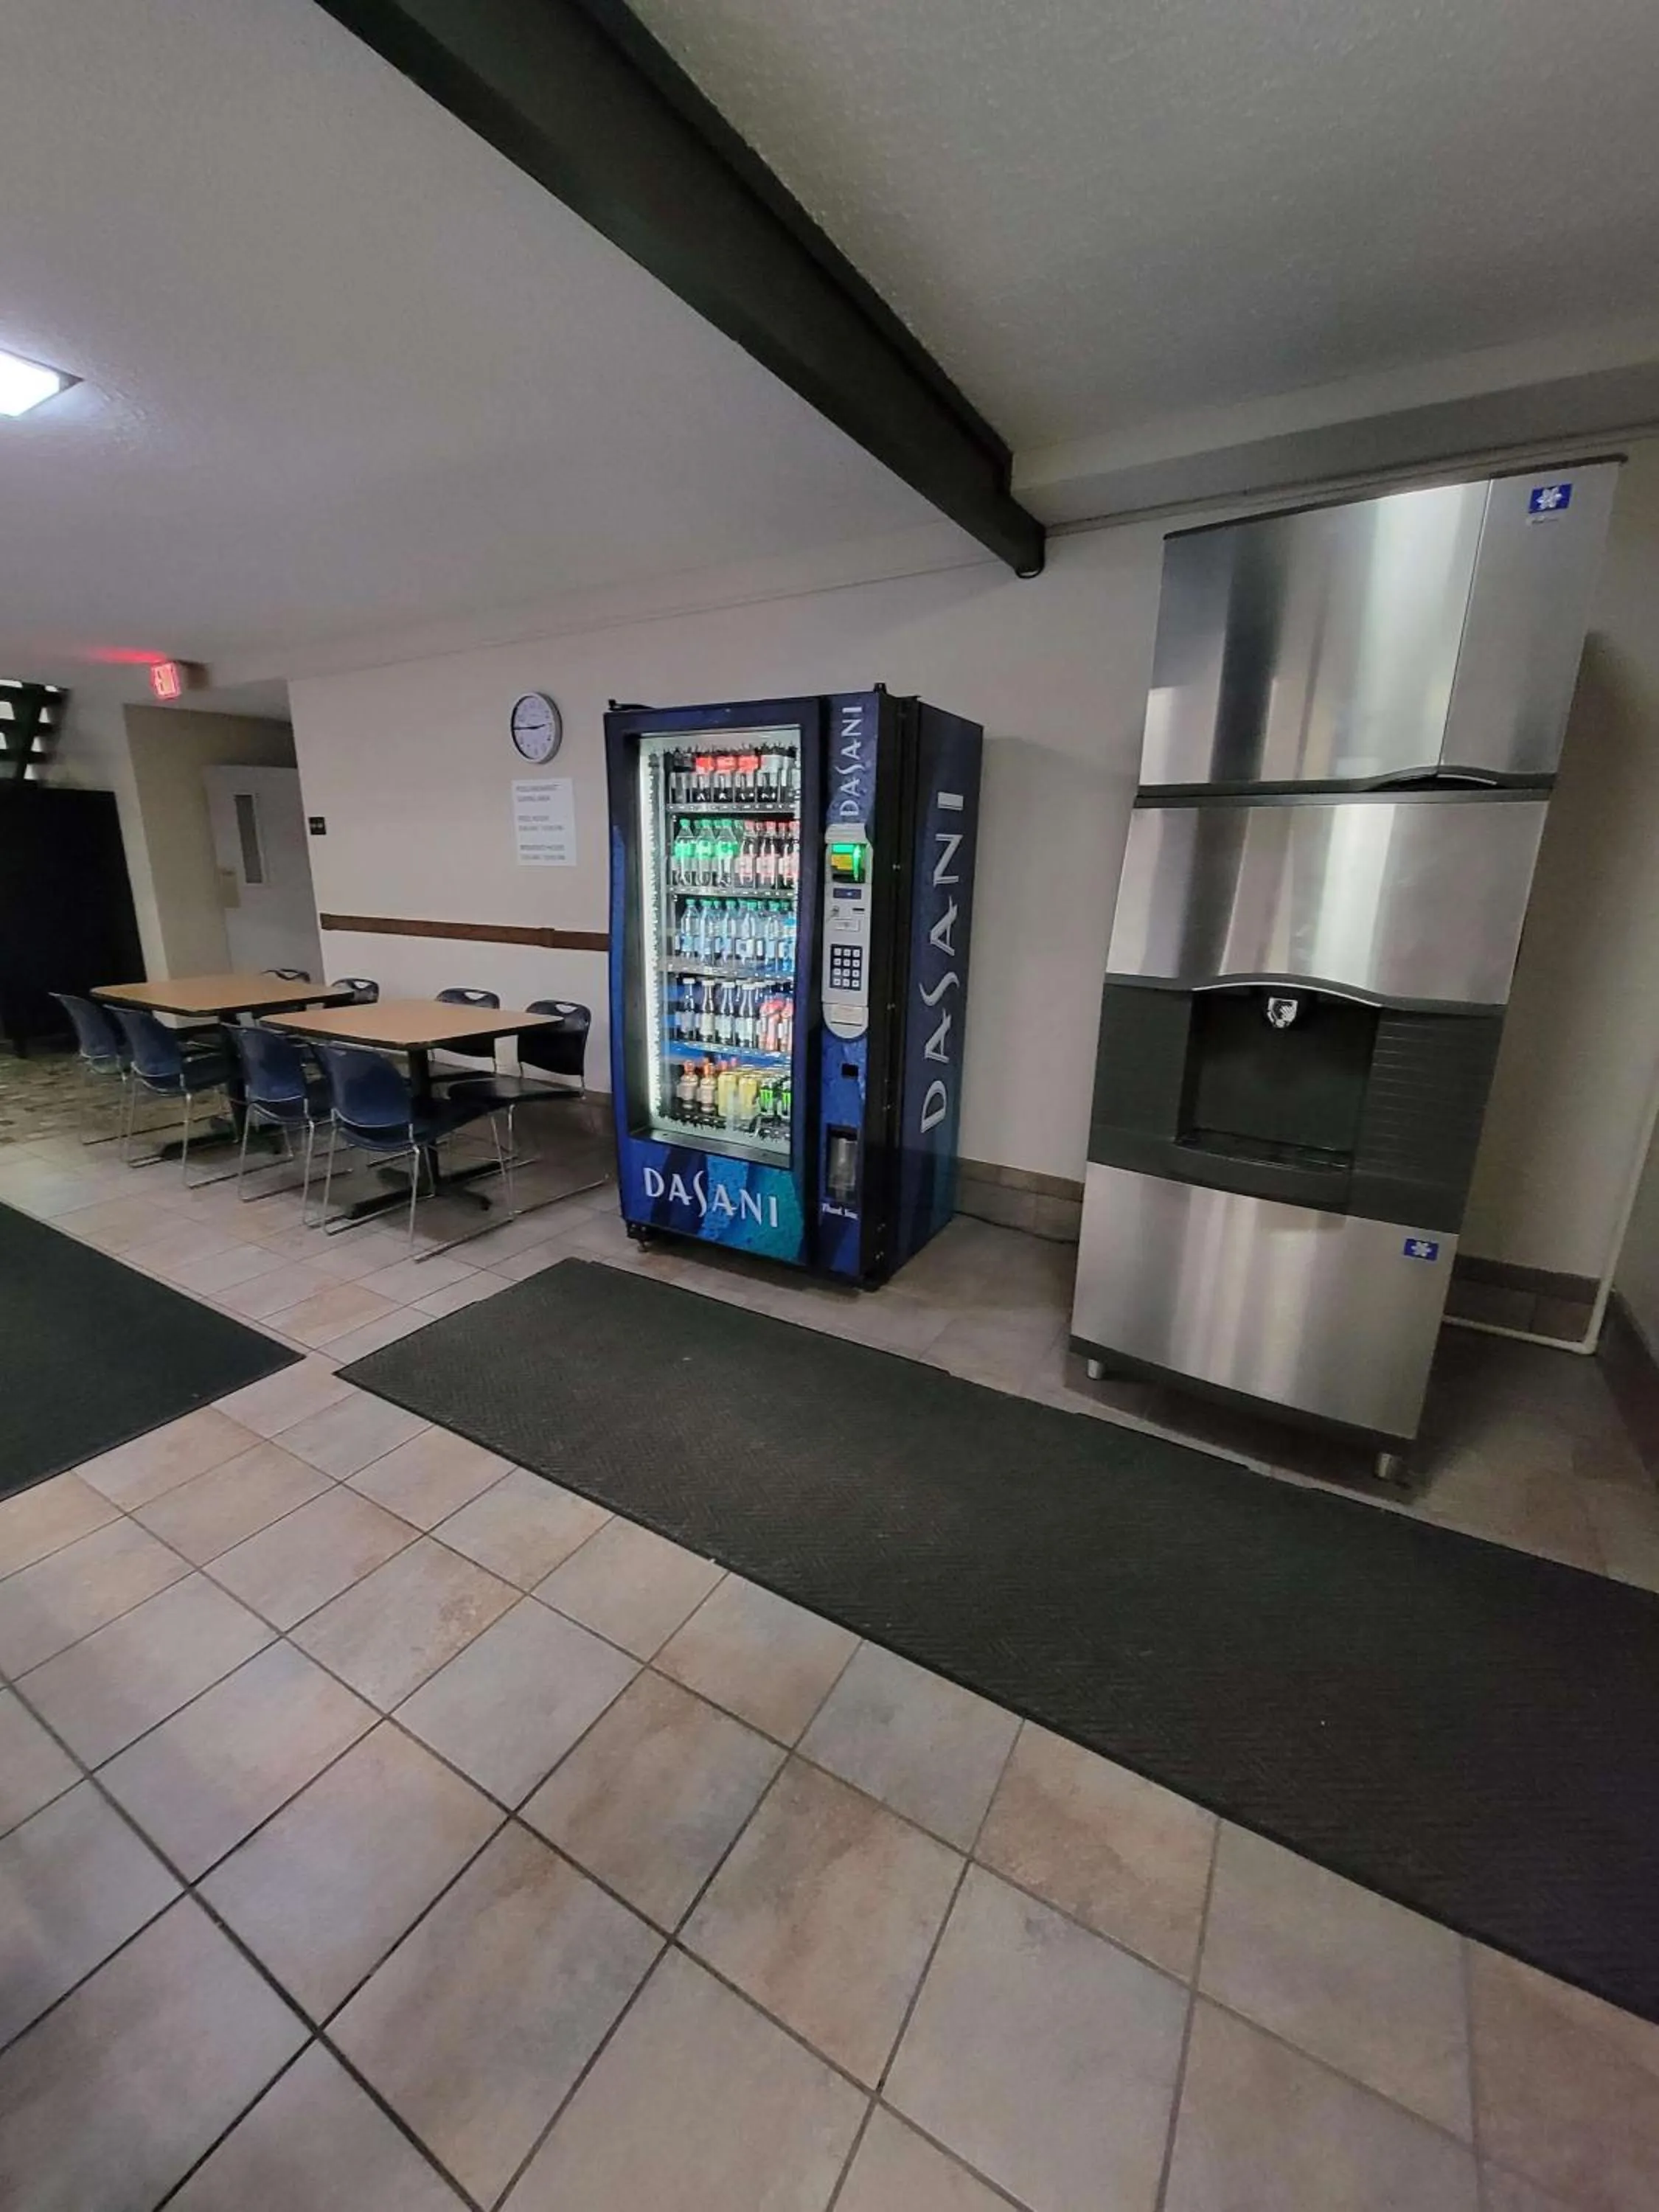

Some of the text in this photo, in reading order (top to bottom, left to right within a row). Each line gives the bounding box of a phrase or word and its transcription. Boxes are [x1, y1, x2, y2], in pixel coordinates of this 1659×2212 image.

[835, 706, 866, 816] DASANI
[919, 791, 964, 1133] DASANI
[643, 1167, 778, 1227] DASANI
